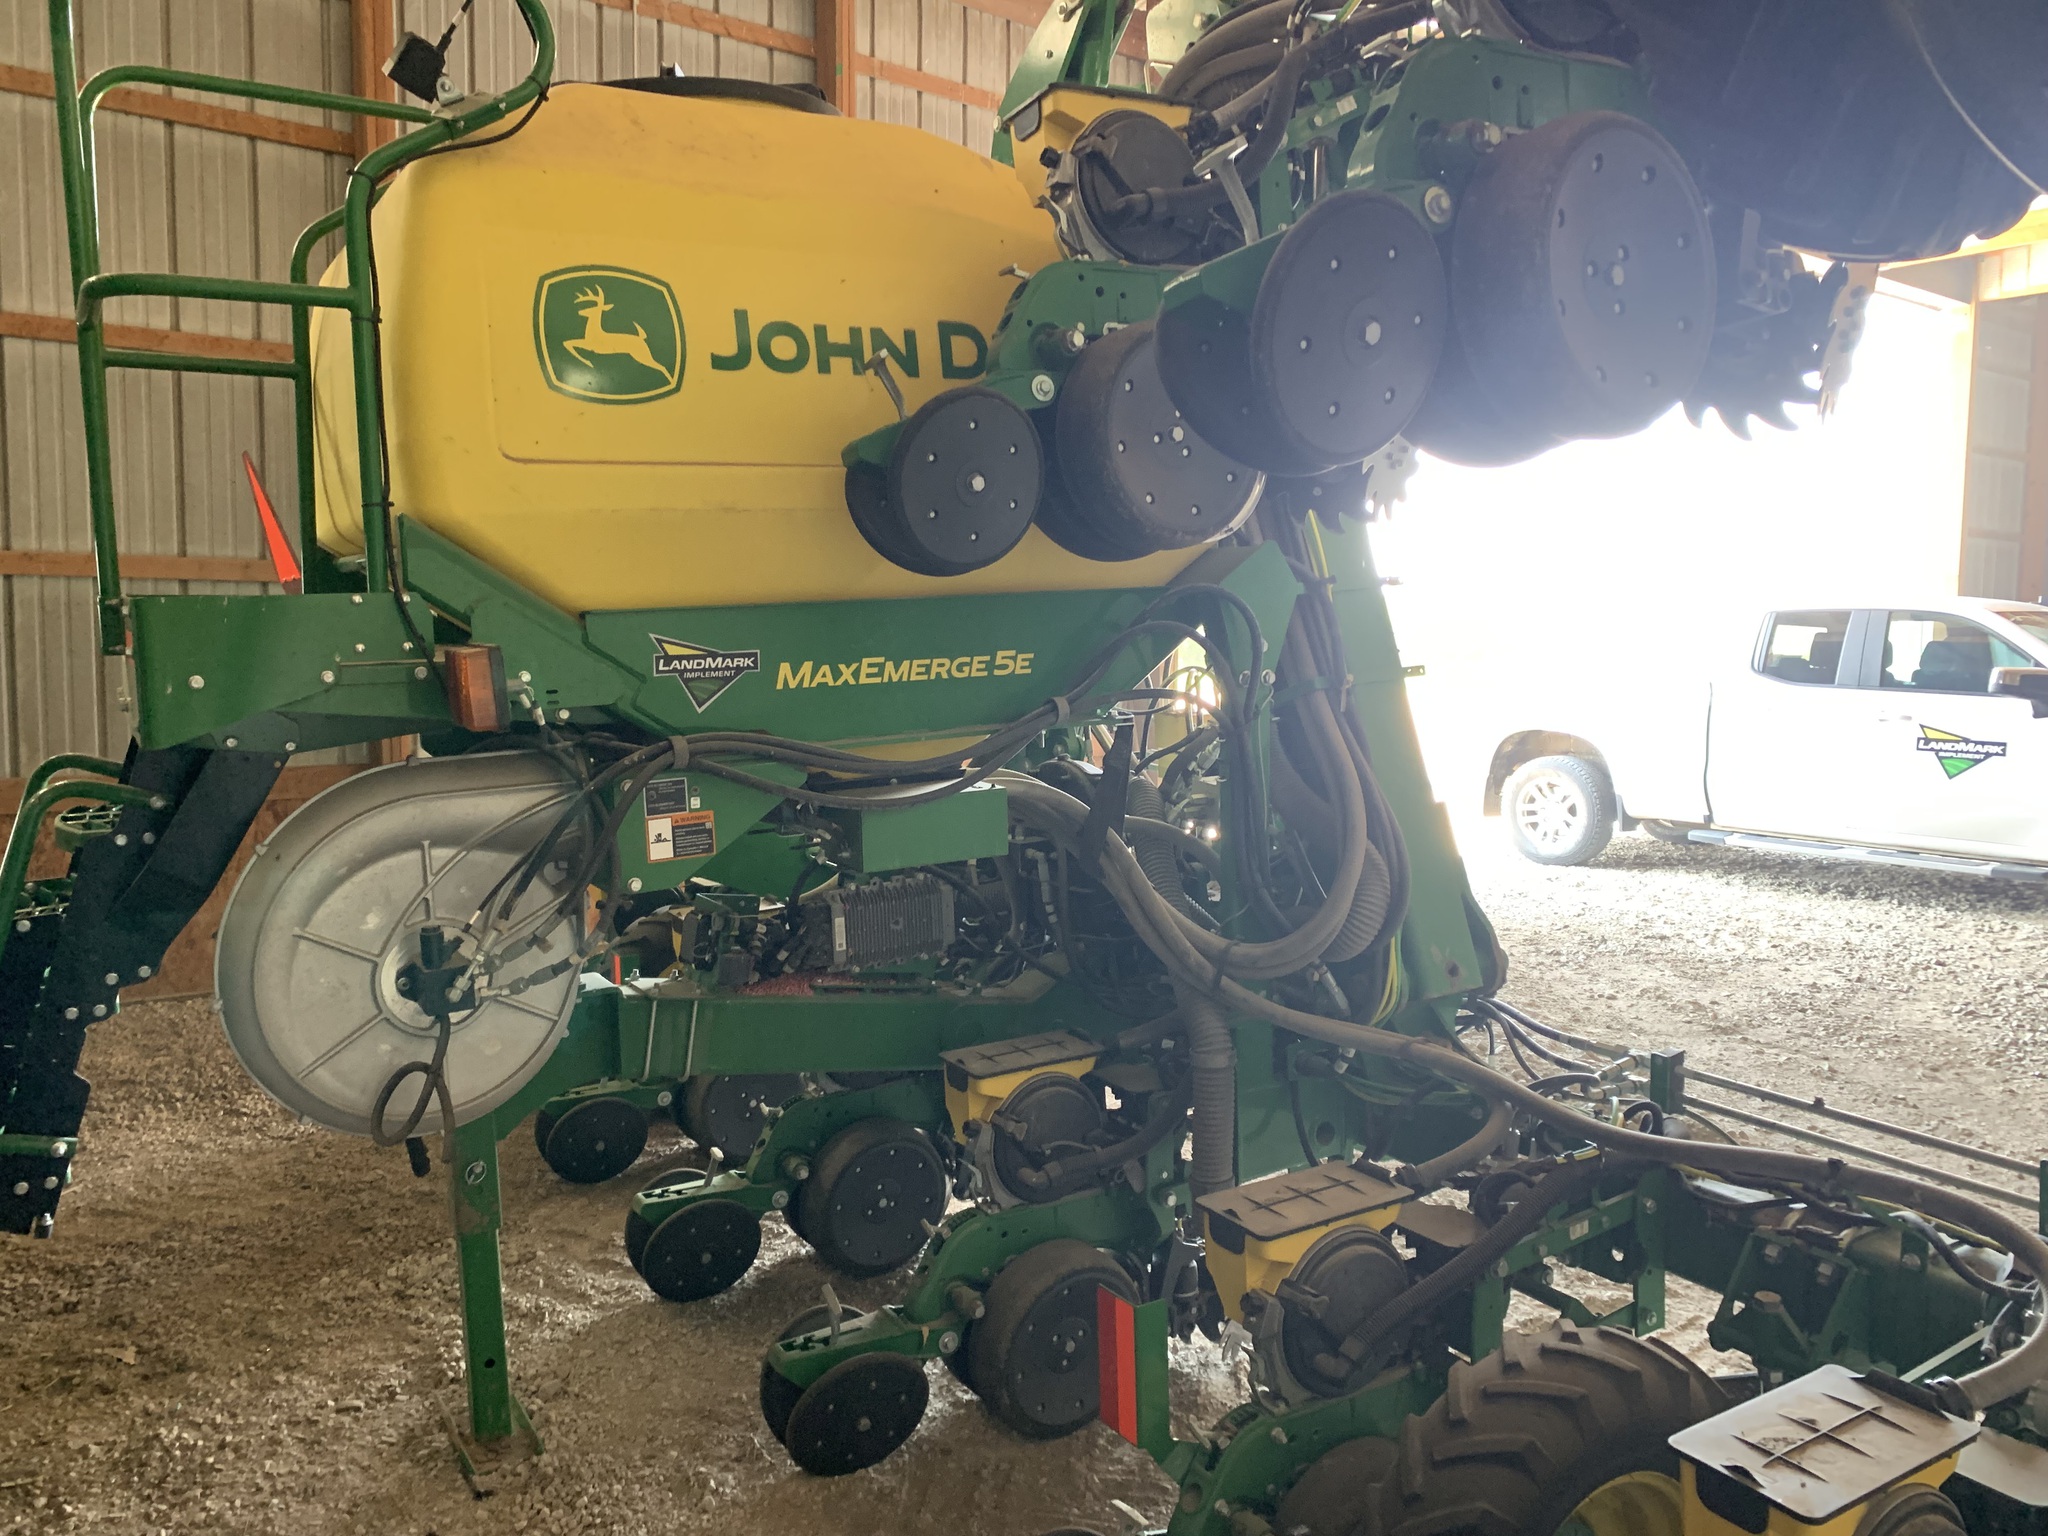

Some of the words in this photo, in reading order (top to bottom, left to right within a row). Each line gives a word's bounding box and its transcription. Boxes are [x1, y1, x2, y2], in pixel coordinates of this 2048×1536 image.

[710, 309, 920, 379] JOHN
[658, 656, 755, 671] LANDMARK
[776, 655, 991, 690] MAXEMERGE
[993, 650, 1035, 677] 5E
[683, 670, 736, 679] IMPLEMENT
[1918, 739, 2005, 754] LANDMARK
[680, 814, 711, 823] WARNING
